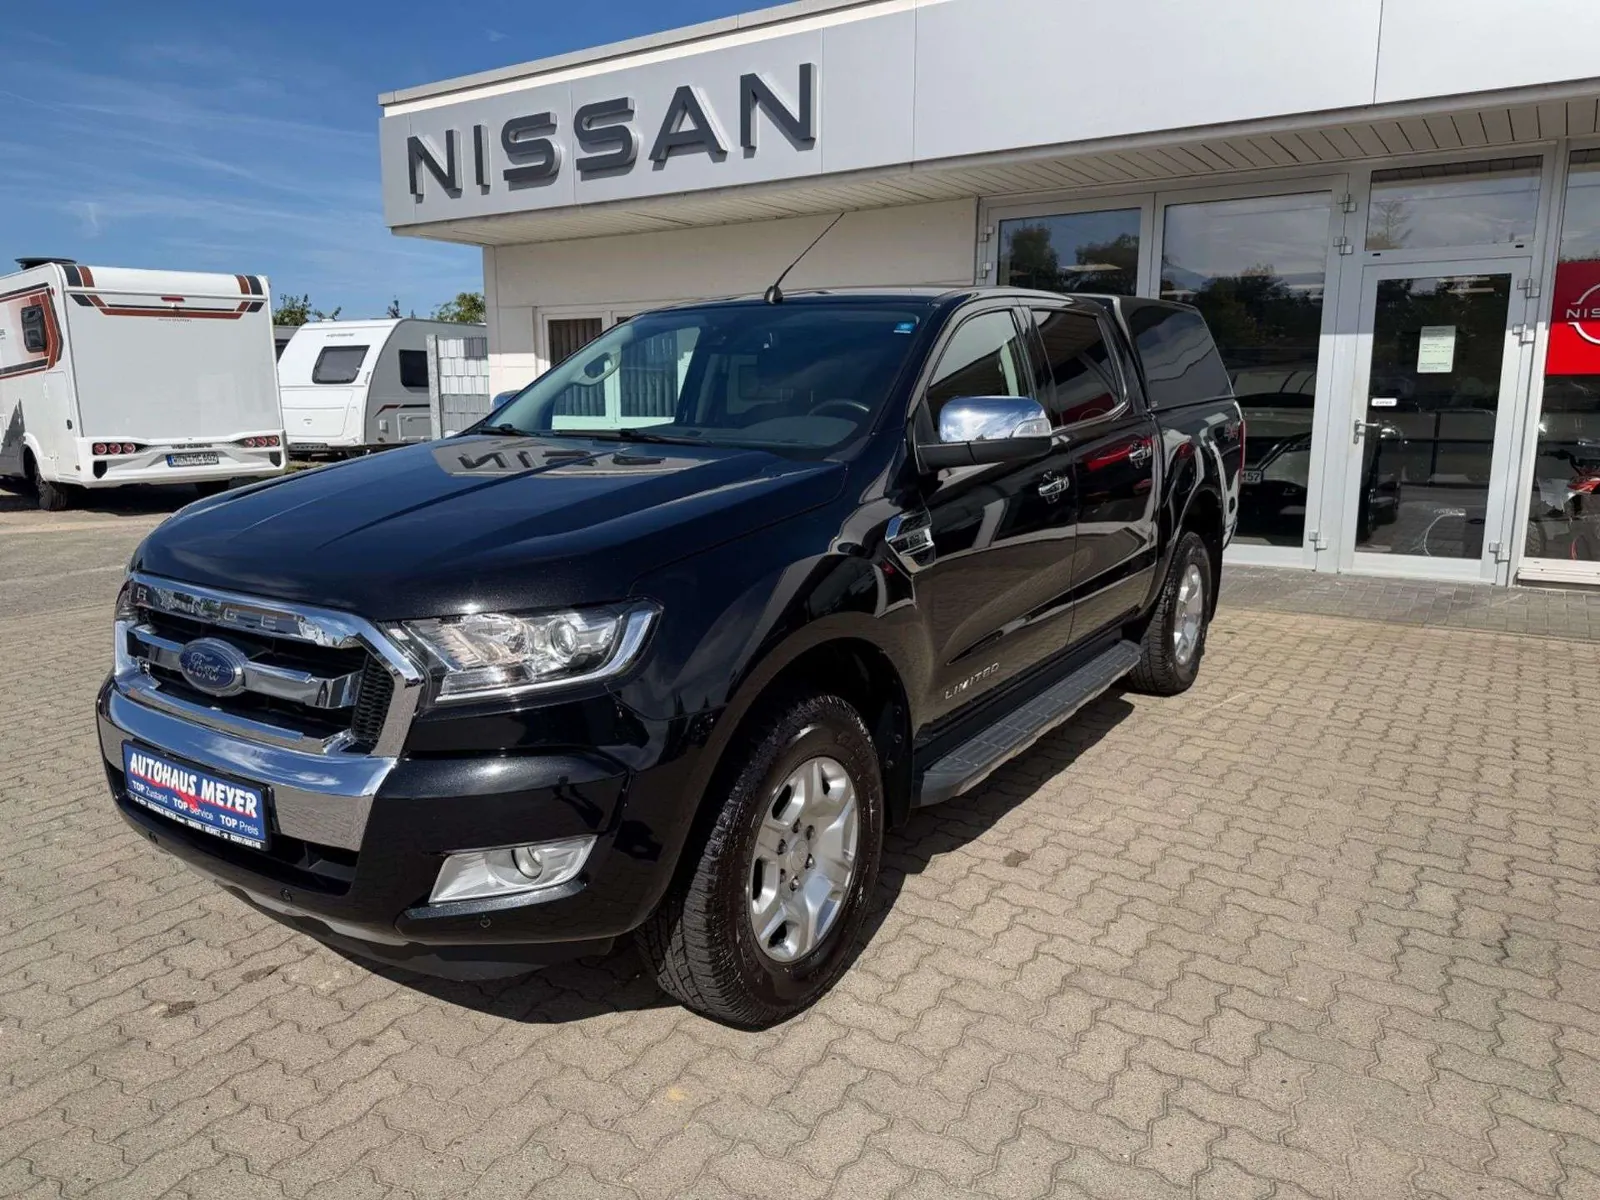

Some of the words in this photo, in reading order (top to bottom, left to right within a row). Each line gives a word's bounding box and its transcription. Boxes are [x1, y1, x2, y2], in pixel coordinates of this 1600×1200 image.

[407, 63, 817, 197] NISSAN
[187, 652, 222, 682] Ford
[945, 662, 1000, 700] LIMITED
[130, 753, 198, 796] AUTOHAUS
[200, 778, 258, 819] MEYER
[131, 780, 145, 793] TOP
[145, 785, 169, 803] Zustand
[172, 797, 189, 811] TOP
[189, 804, 214, 821] Service
[220, 814, 238, 829] TOP
[239, 820, 260, 836] Preis
